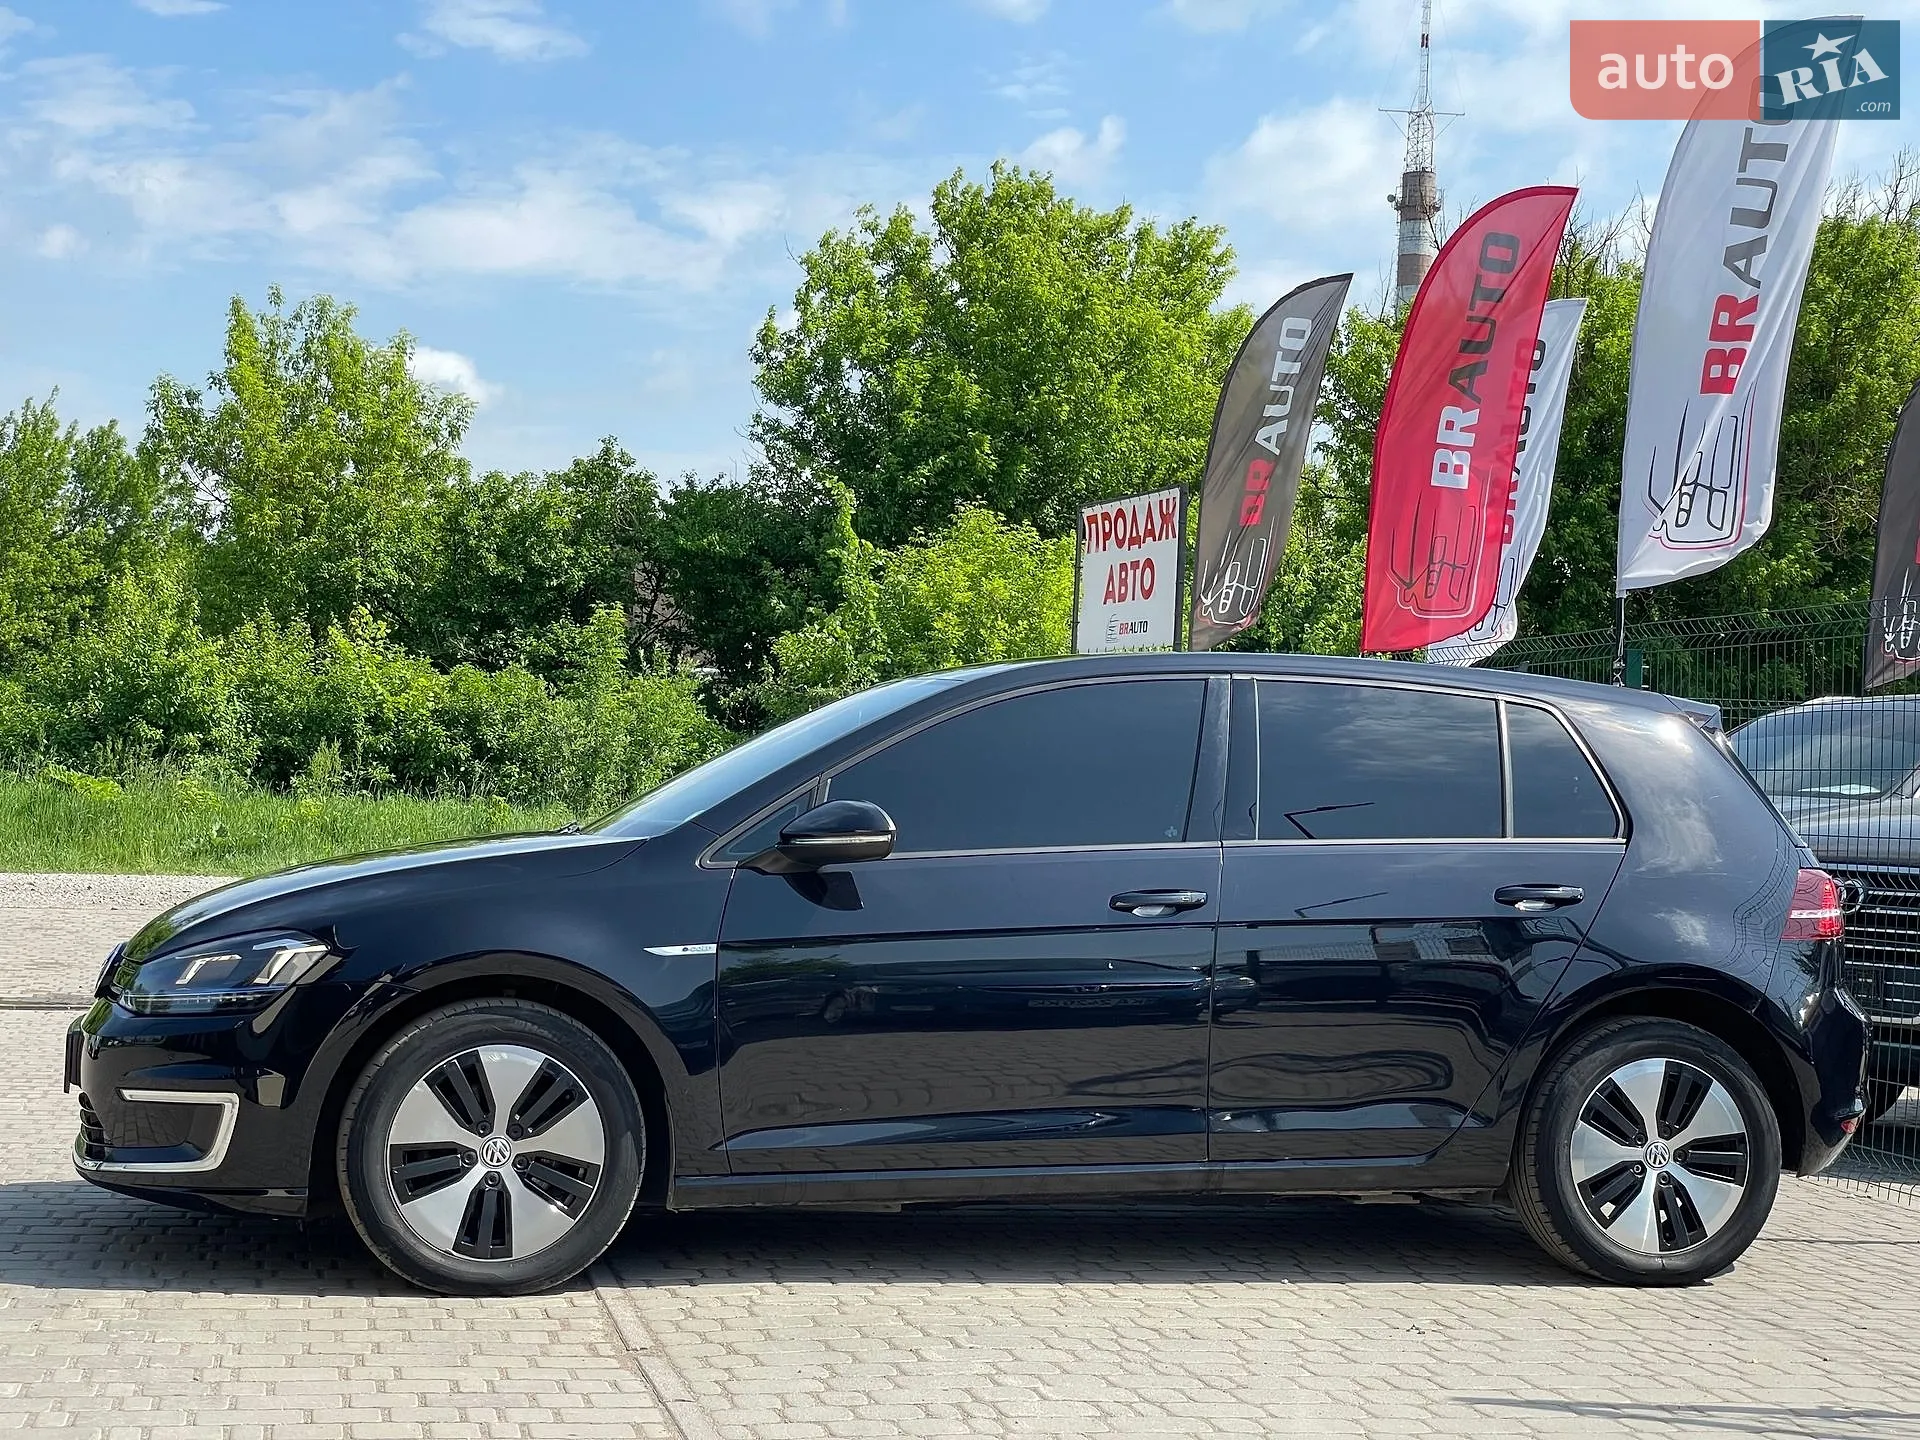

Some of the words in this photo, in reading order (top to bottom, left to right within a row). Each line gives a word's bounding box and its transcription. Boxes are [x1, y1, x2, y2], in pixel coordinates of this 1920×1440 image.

[1430, 231, 1520, 490] BRAUTO
[1239, 316, 1313, 526] BRAUTO
[1086, 497, 1177, 554] ПРОДАЖ
[1103, 557, 1155, 605] АВТО
[1119, 620, 1148, 635] BRAUTO
